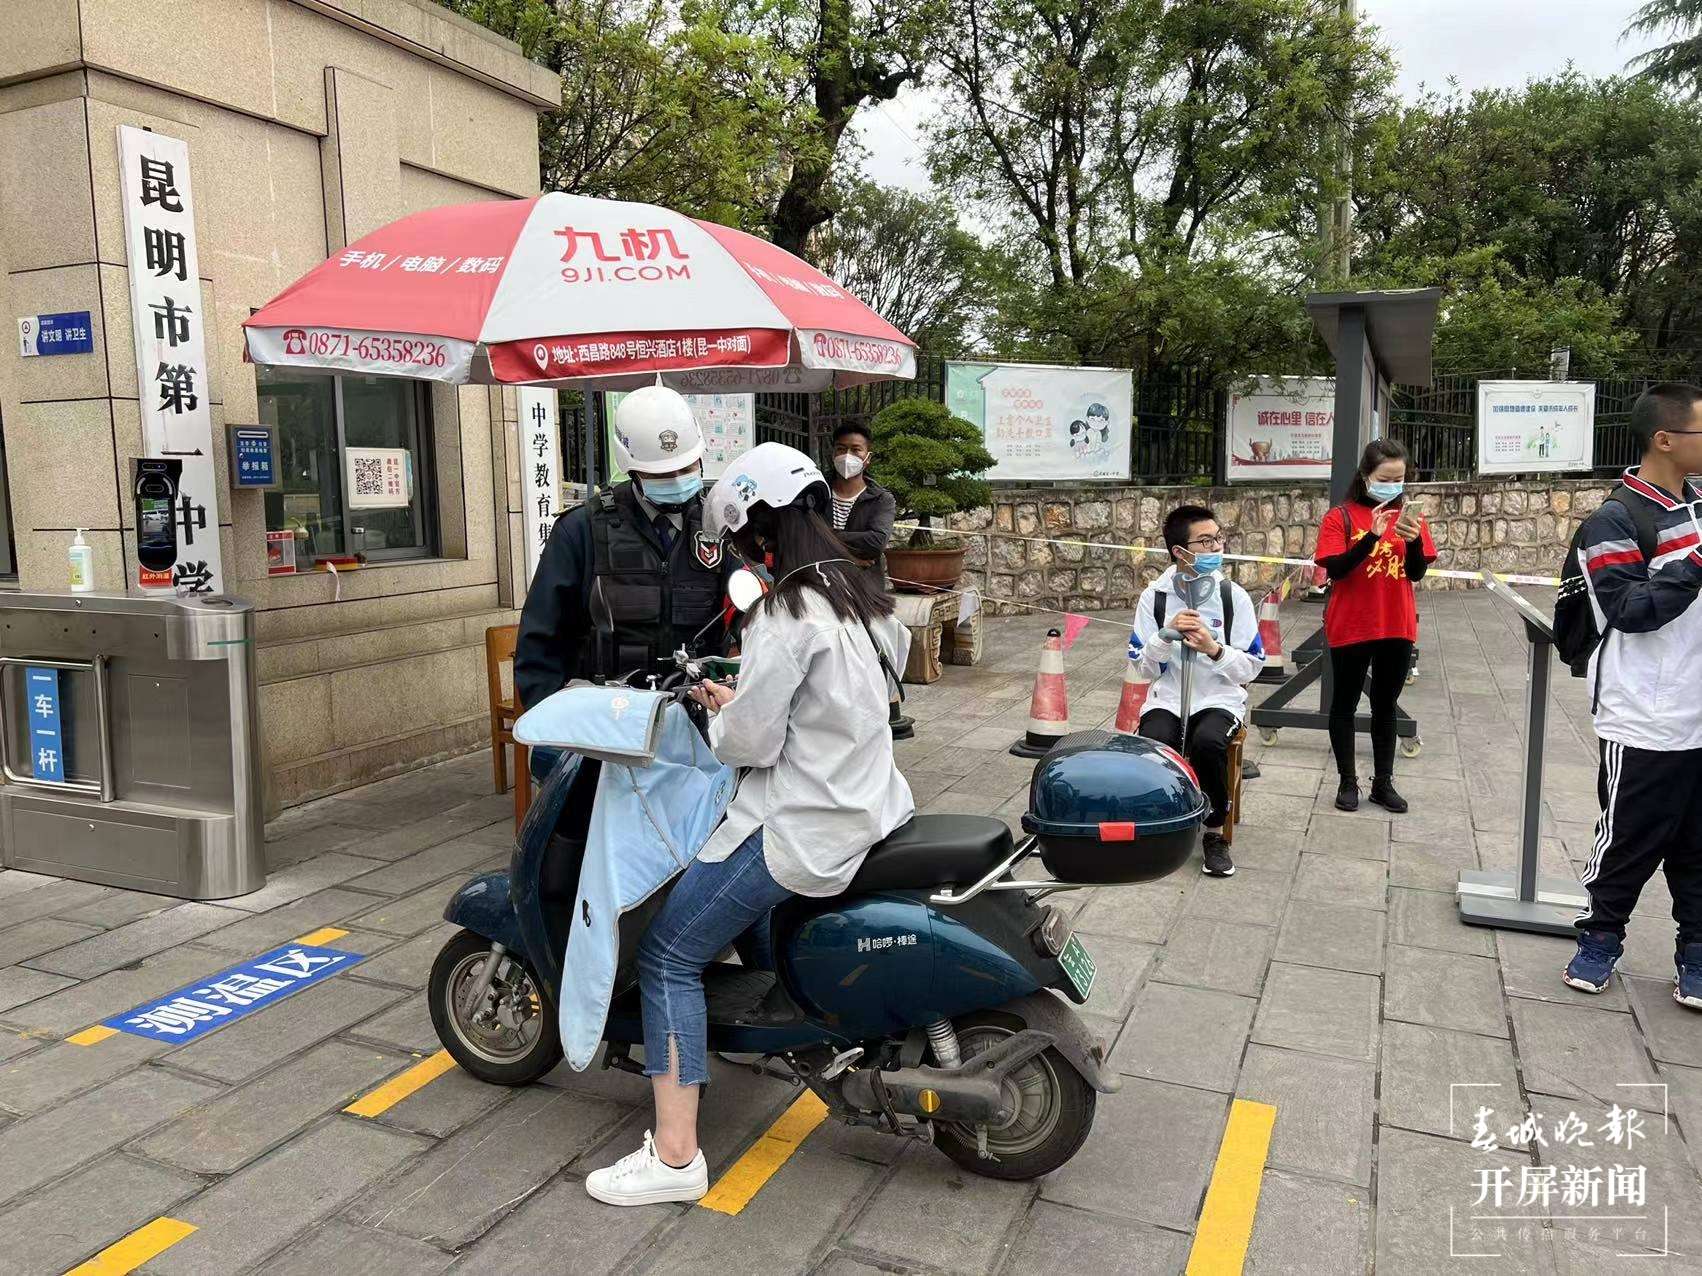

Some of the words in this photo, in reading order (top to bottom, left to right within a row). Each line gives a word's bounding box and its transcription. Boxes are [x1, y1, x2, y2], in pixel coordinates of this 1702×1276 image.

[554, 226, 690, 263] 九机
[561, 265, 691, 283] 9JI.COM
[309, 332, 446, 368] 0871-65358236
[531, 402, 551, 562] 中学教育集
[33, 675, 58, 772] 一车一杆
[124, 948, 347, 1035] 测温区
